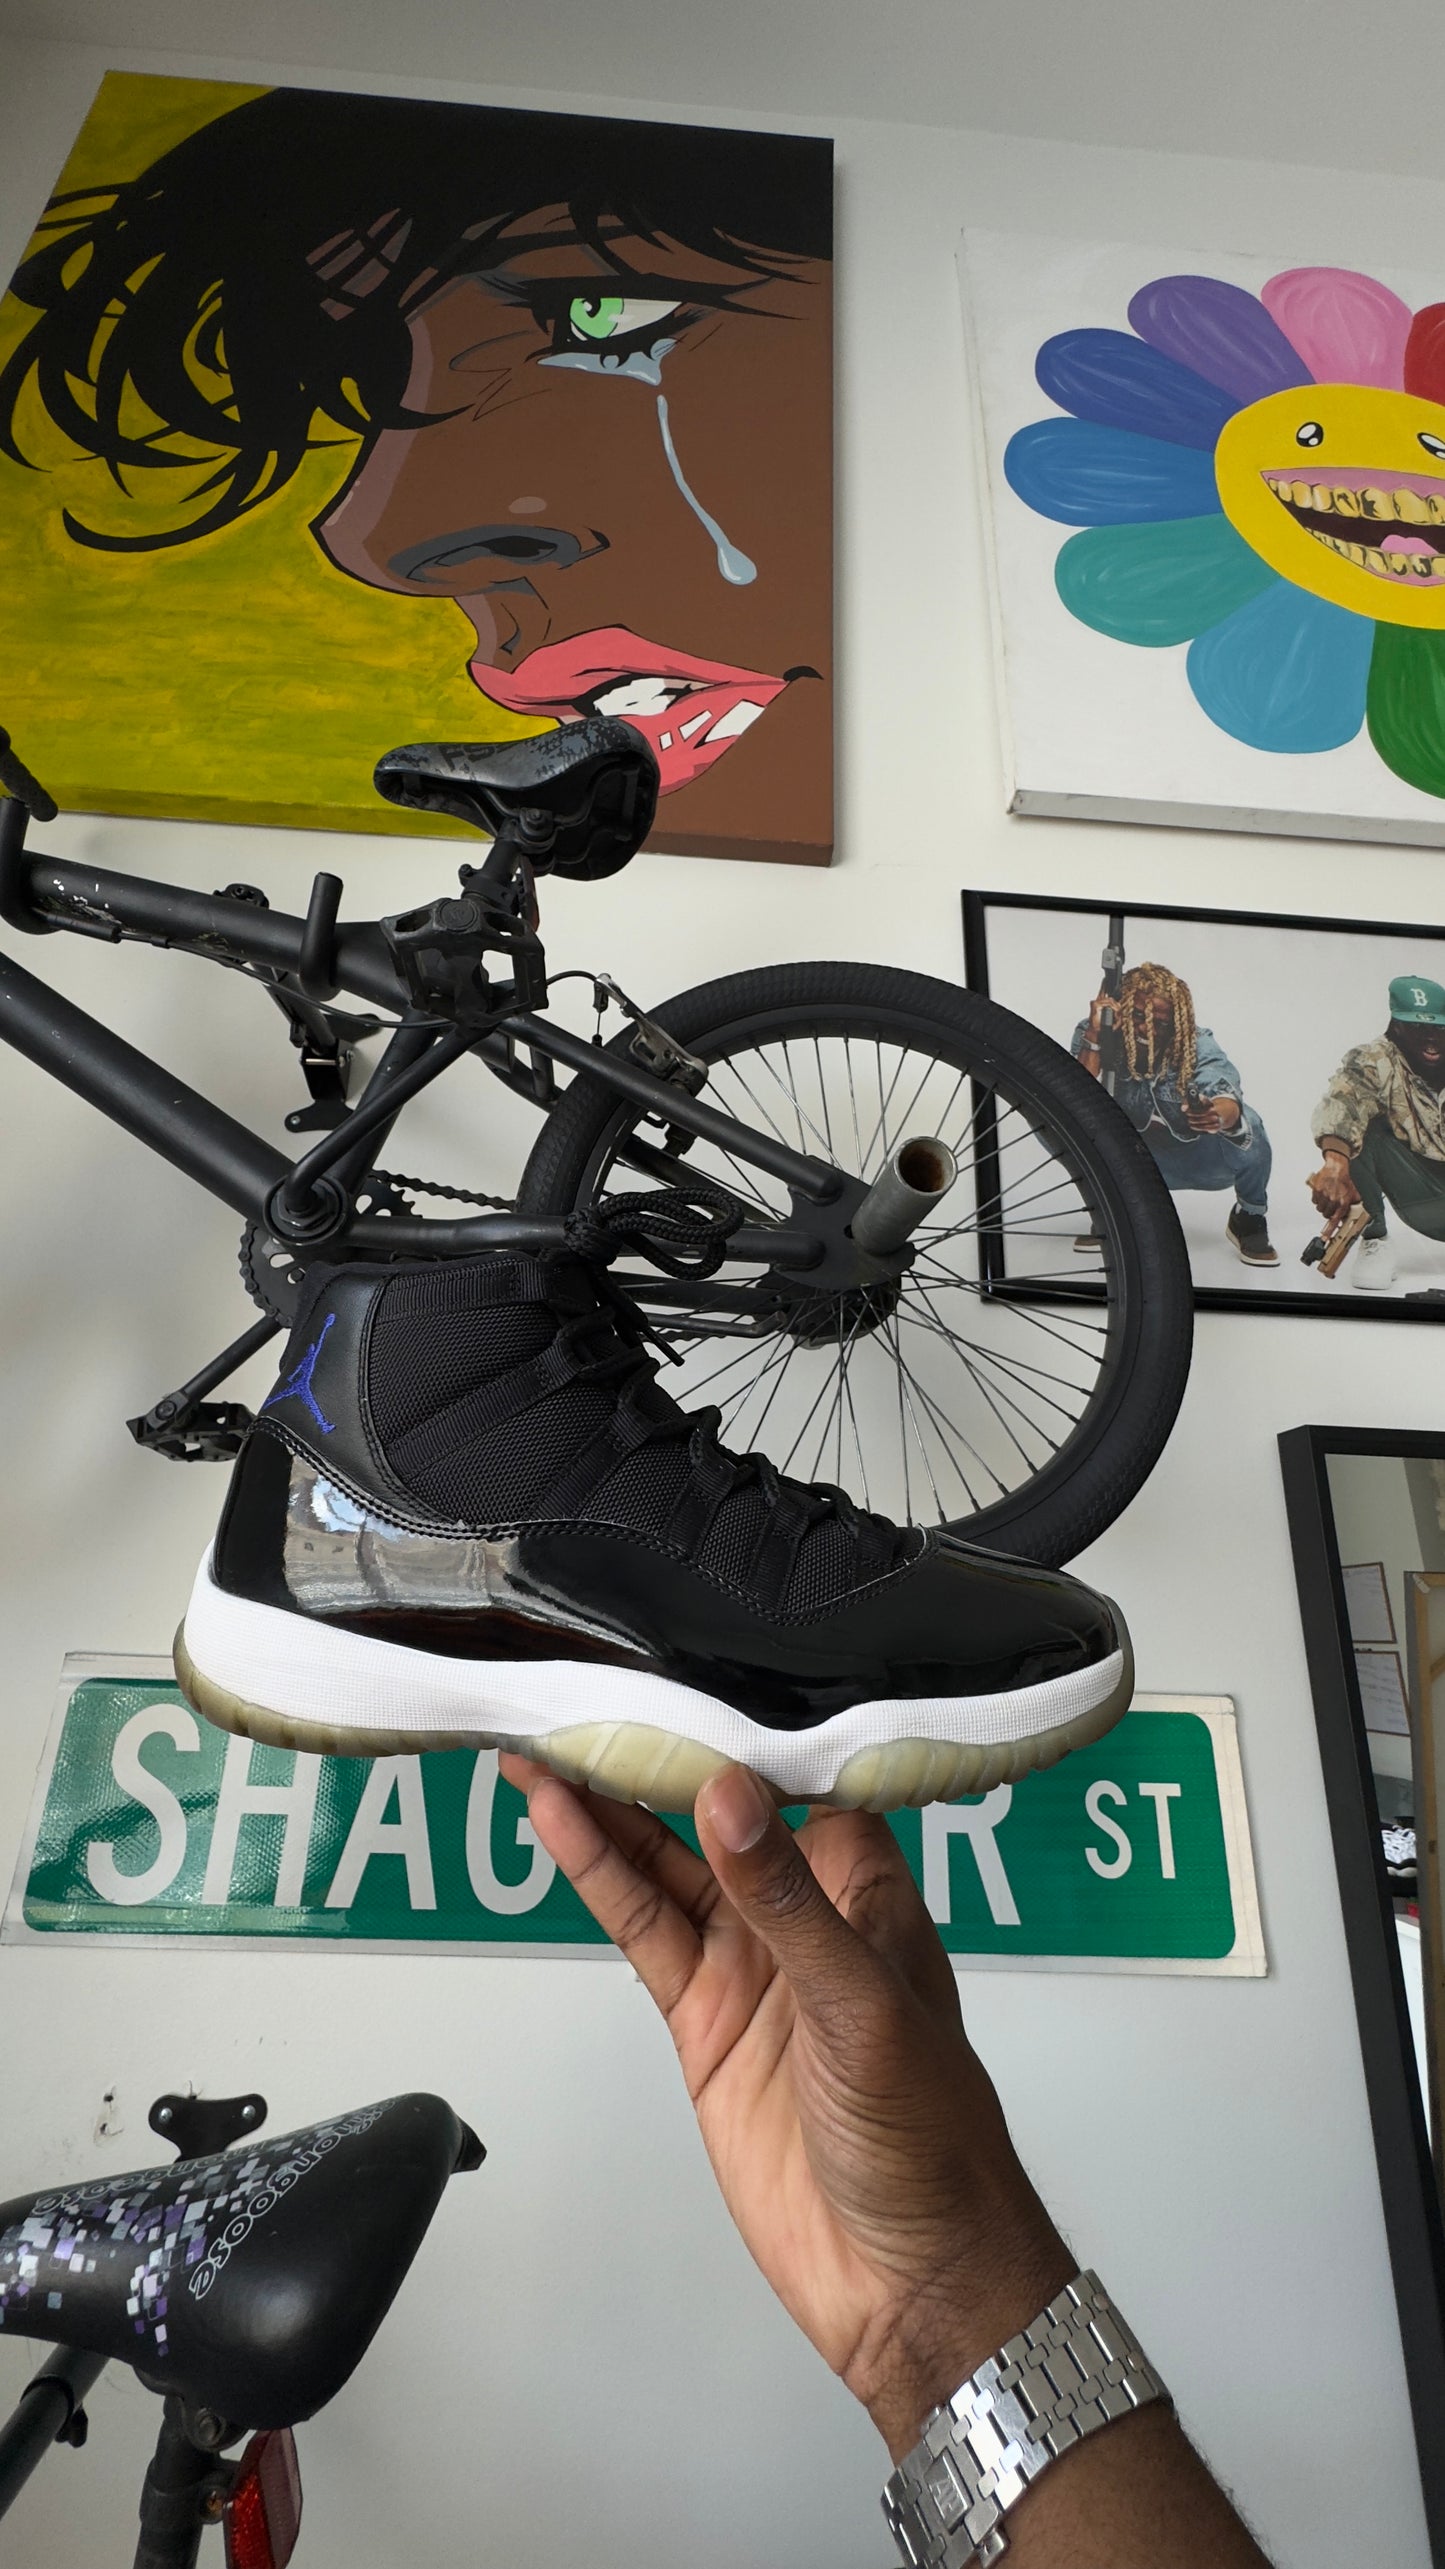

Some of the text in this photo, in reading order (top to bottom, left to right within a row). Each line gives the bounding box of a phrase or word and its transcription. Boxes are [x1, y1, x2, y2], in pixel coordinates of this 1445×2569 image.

[1410, 988, 1428, 1007] B
[1084, 1780, 1182, 1880] ST
[188, 2116, 374, 2300] mongoose
